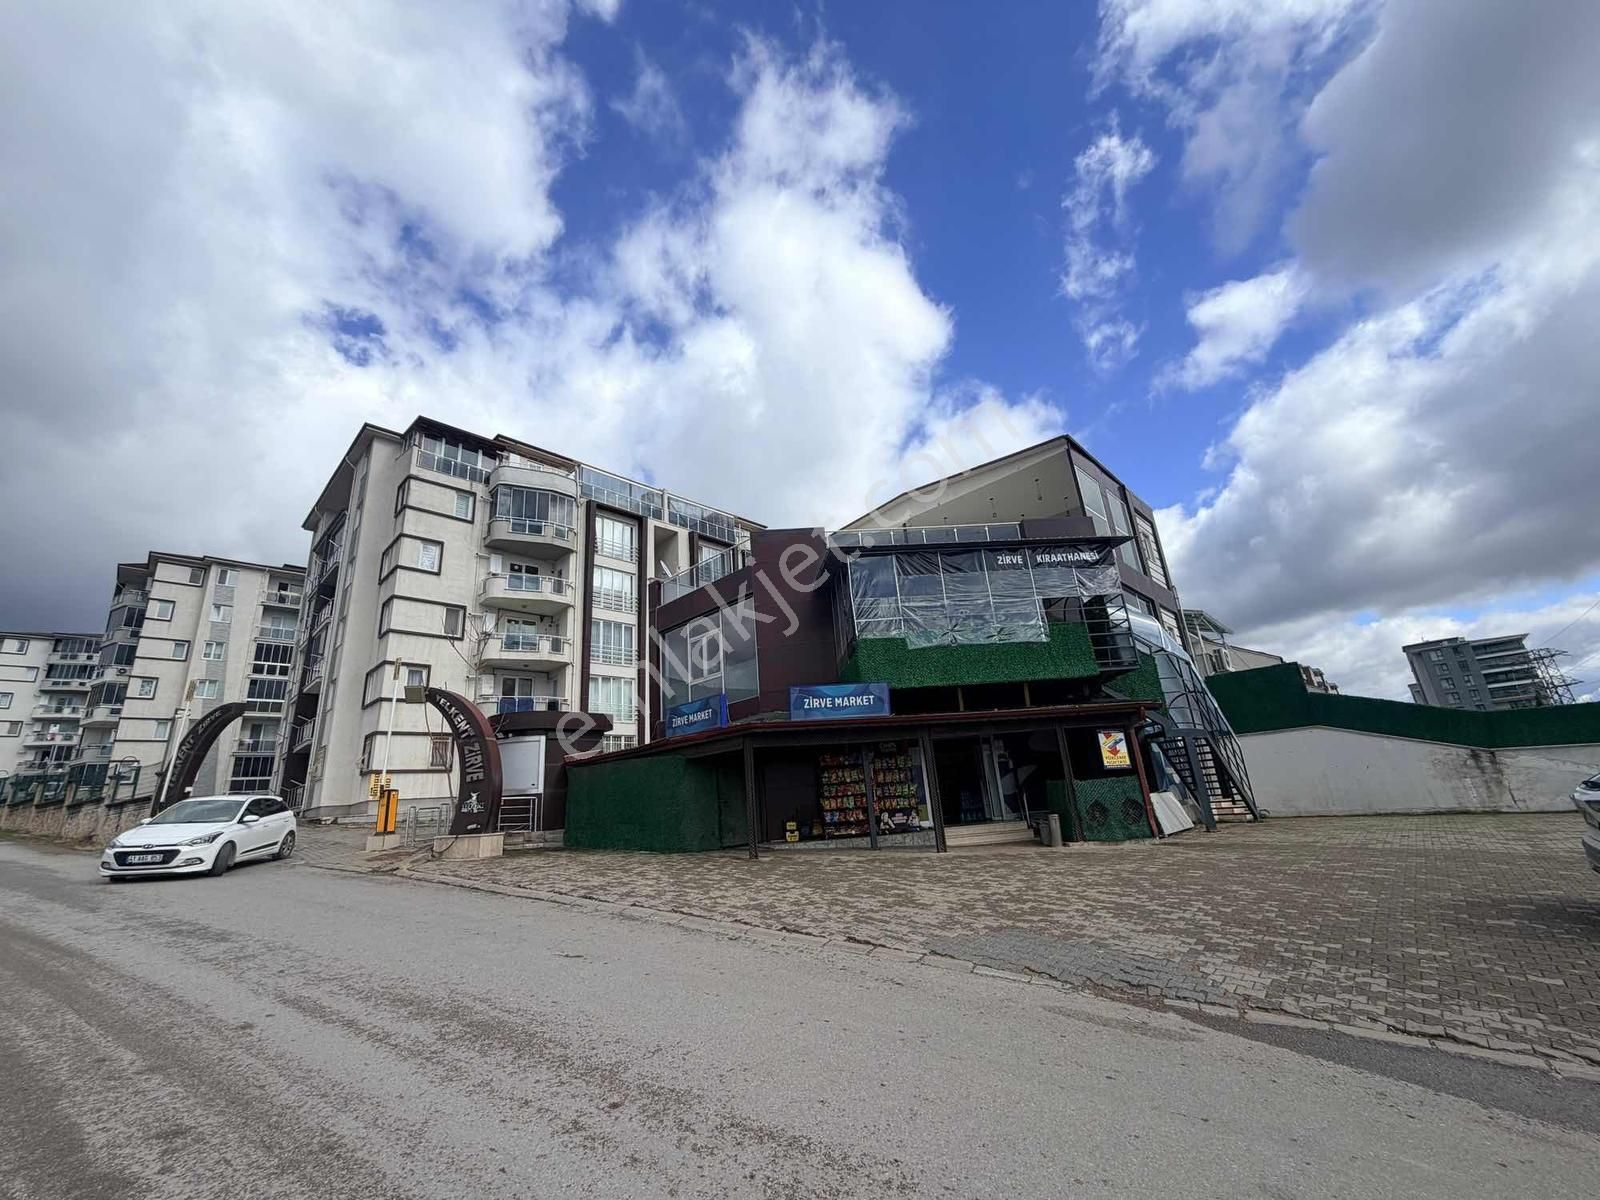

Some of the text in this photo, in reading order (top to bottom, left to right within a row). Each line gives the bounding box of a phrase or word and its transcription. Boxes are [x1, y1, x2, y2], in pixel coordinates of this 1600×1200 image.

[997, 550, 1100, 565] ZİRVE KIRAATHANESİ
[804, 694, 875, 709] ZİRVE MARKET
[672, 708, 712, 728] ZİRVE MARKET
[435, 694, 476, 739] YELKENT
[464, 742, 484, 783] ZİRVE
[169, 734, 194, 787] LKENT
